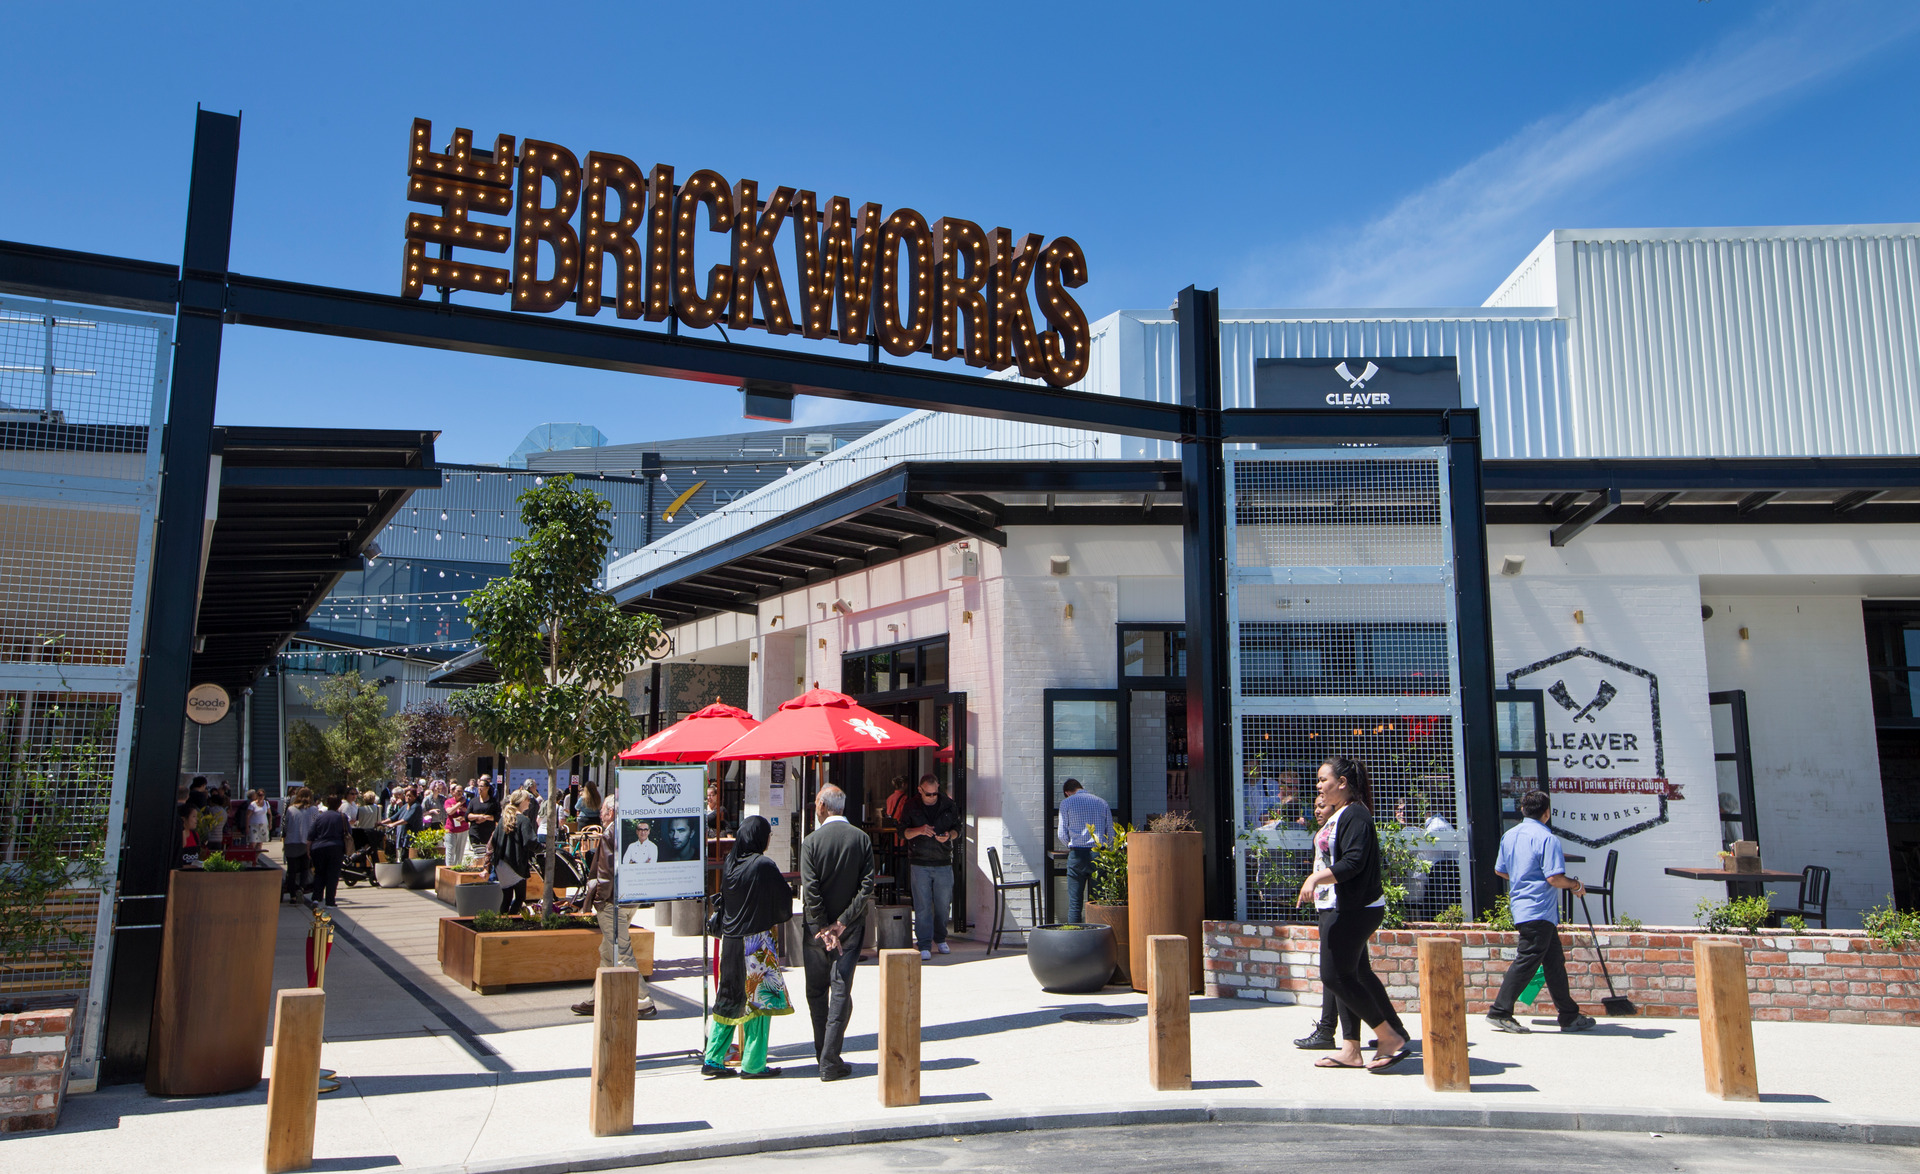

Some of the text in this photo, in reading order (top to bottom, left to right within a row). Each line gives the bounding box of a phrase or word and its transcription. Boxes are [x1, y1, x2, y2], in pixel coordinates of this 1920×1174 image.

[402, 117, 1089, 388] THE BRICKWORKS
[1325, 393, 1391, 405] CLEAVER
[189, 697, 226, 708] Goode
[1545, 732, 1639, 751] LEAVER
[1563, 754, 1616, 770] & CO.
[641, 783, 682, 796] BRICKWORKS
[1515, 780, 1666, 793] EAT BEER MEAT DRINK BETTER LIQUOR
[664, 806, 701, 814] NOVEMBER
[1551, 806, 1641, 822] RICKWORKS
